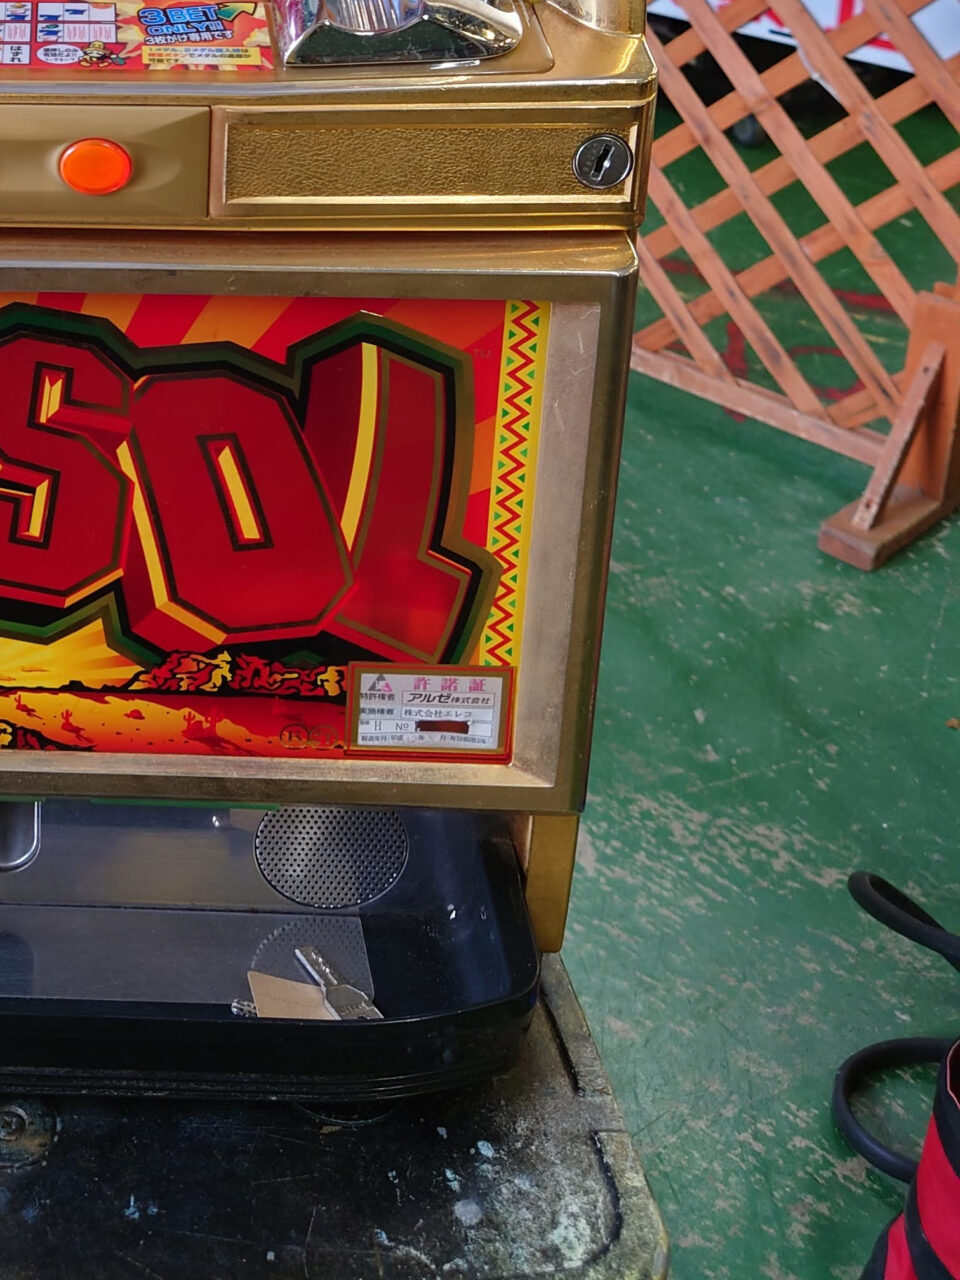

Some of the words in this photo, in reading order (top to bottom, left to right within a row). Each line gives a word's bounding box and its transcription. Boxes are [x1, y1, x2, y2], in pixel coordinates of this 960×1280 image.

[139, 8, 165, 25] 3
[166, 5, 218, 23] BET
[144, 31, 234, 45] 3枚がけ専用です
[407, 693, 491, 705] アルゼ株式会社
[404, 709, 473, 718] 株式会社エレコ
